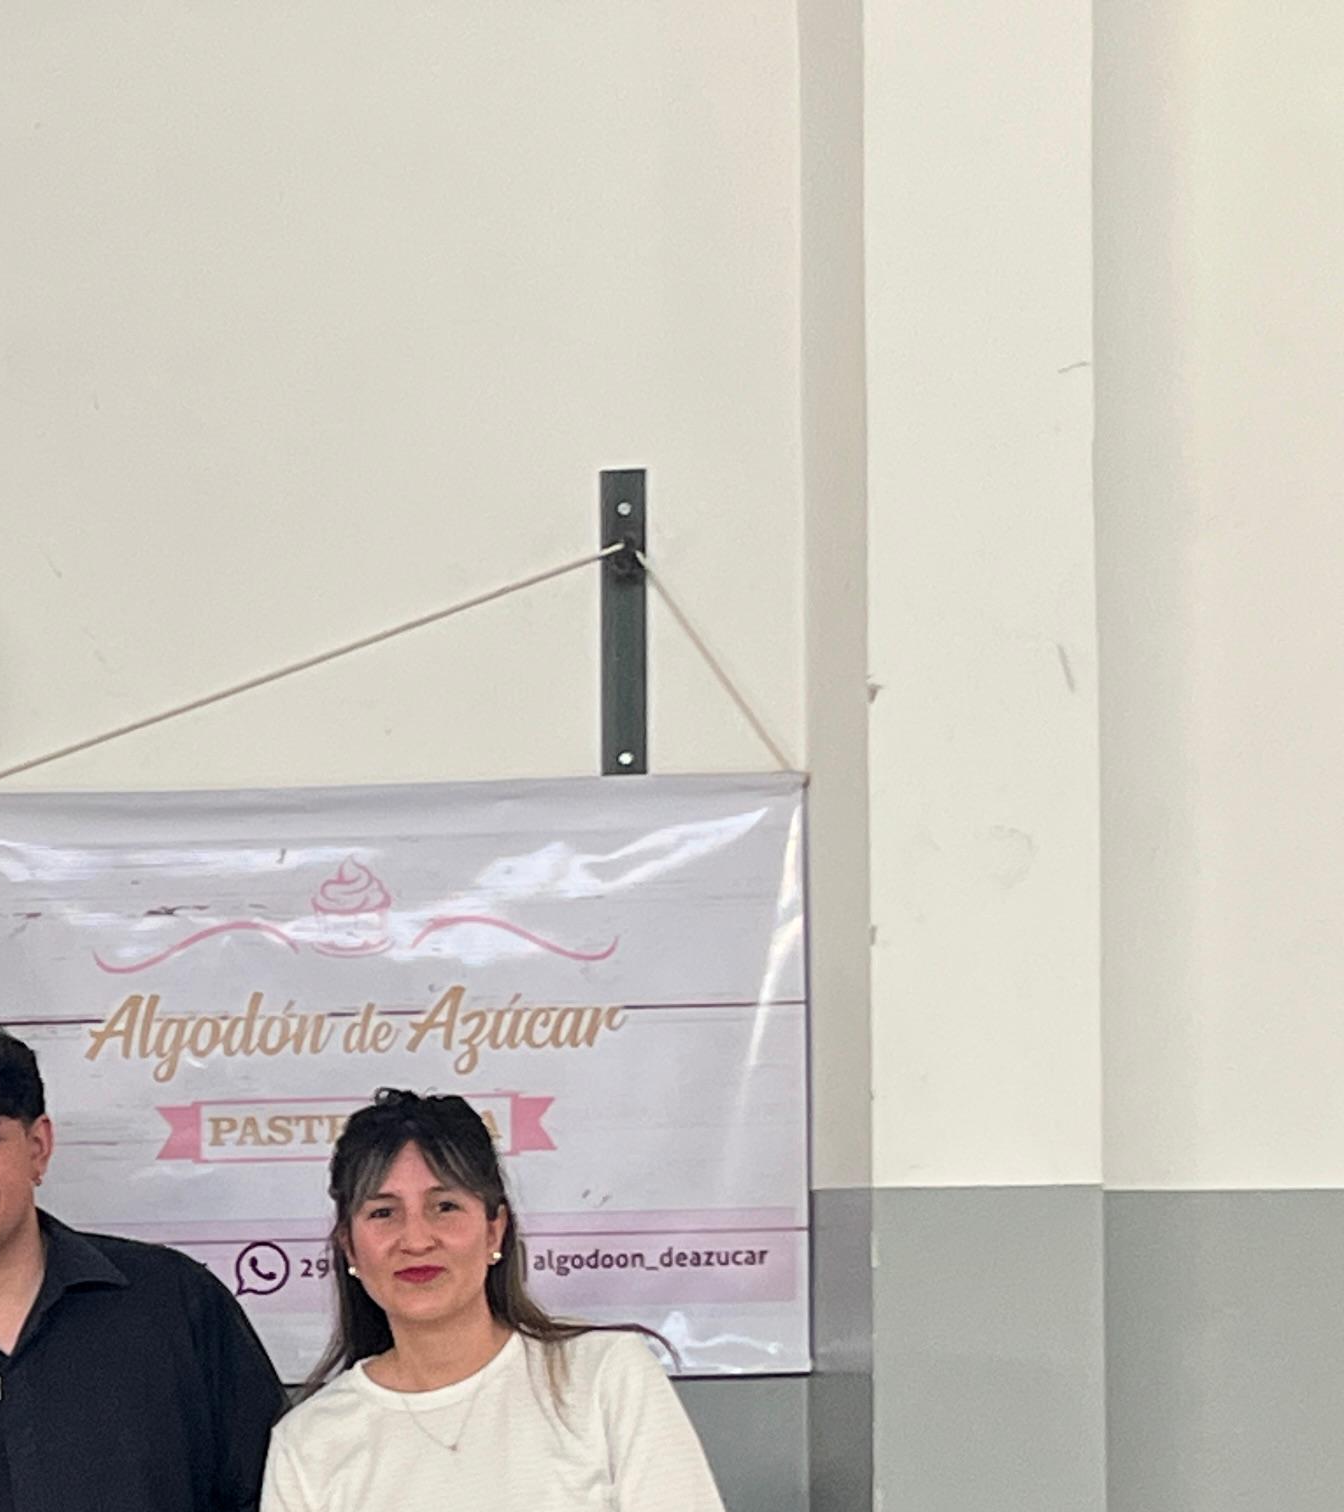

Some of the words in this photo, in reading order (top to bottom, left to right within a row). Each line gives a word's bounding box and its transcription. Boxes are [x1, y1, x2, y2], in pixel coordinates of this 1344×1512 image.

[84, 991, 334, 1083] Algodón
[343, 1002, 400, 1054] de
[406, 984, 627, 1075] Azúcar
[533, 1246, 769, 1276] algodoon_deazucar
